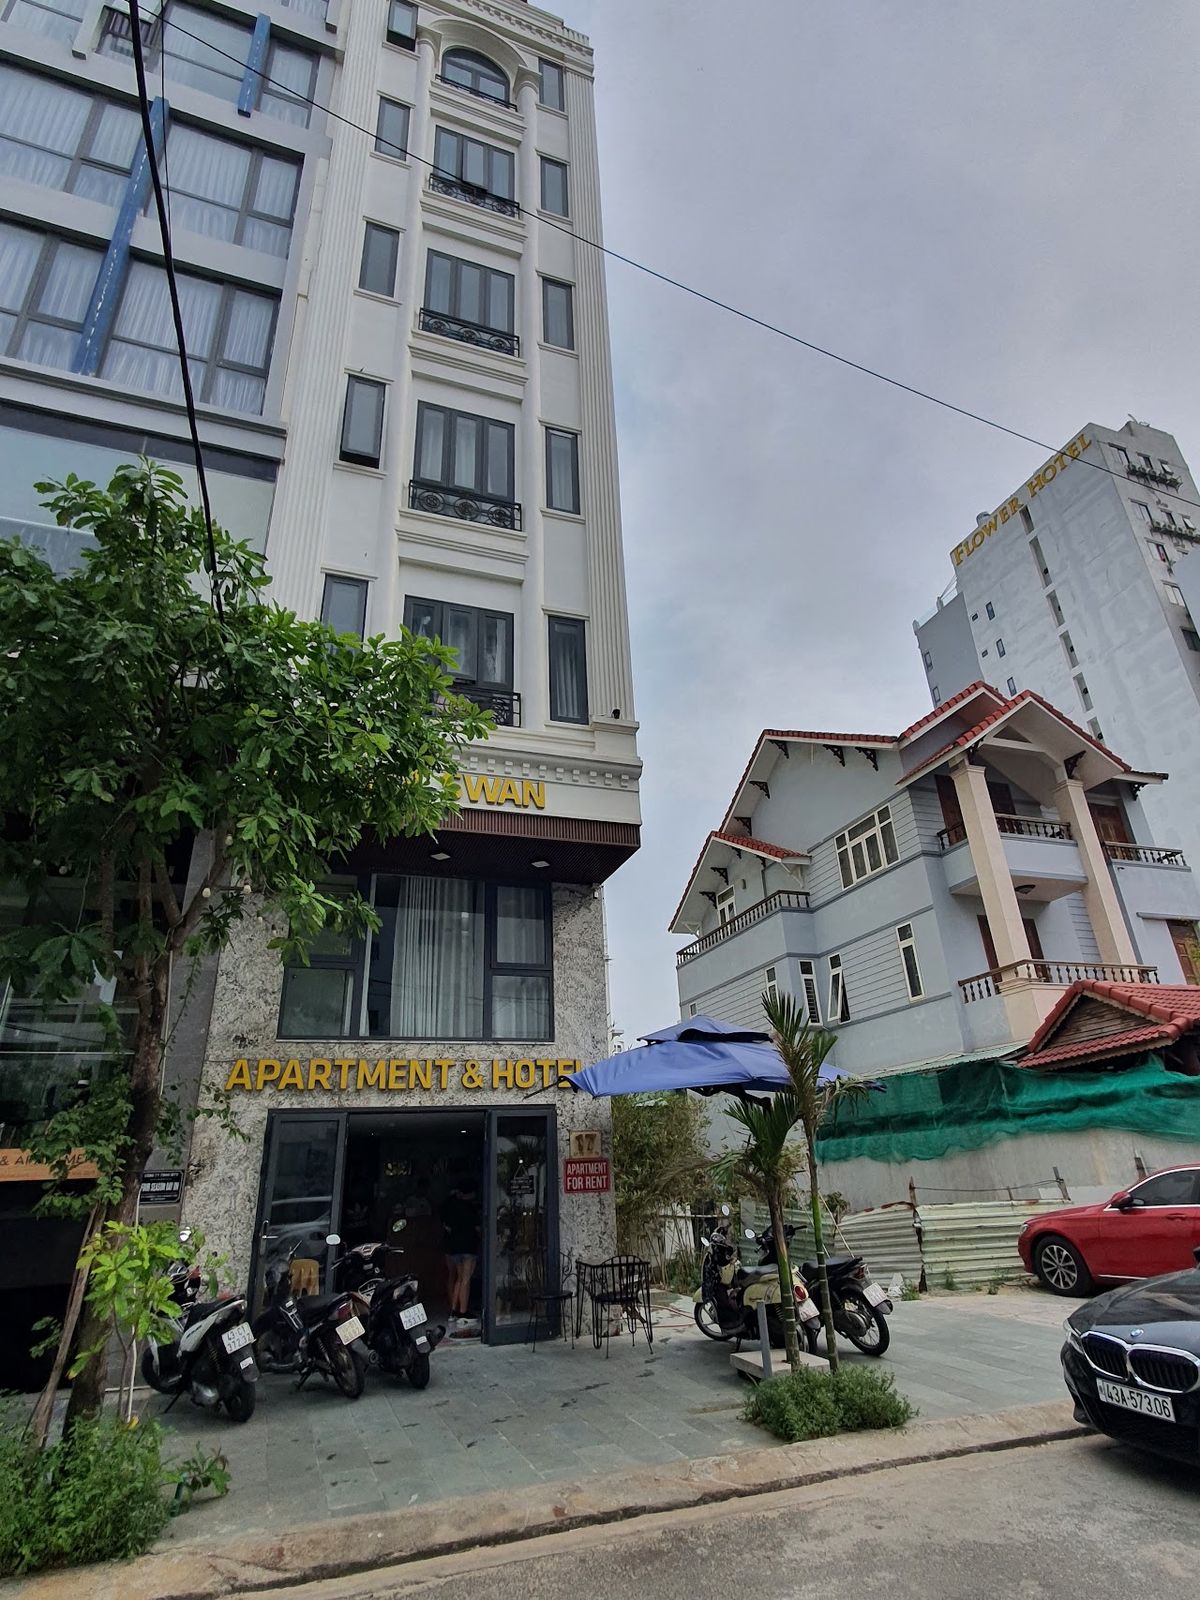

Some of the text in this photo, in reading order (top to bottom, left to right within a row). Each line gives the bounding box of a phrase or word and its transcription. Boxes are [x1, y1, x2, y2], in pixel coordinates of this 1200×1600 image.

[953, 434, 1092, 566] FLOWER HOTEL
[225, 1058, 456, 1091] APARTMENT
[461, 1058, 483, 1089] &
[567, 1162, 607, 1175] APARTMENT
[567, 1175, 607, 1190] FOR RENT
[1106, 1383, 1171, 1418] 43A-573.06
